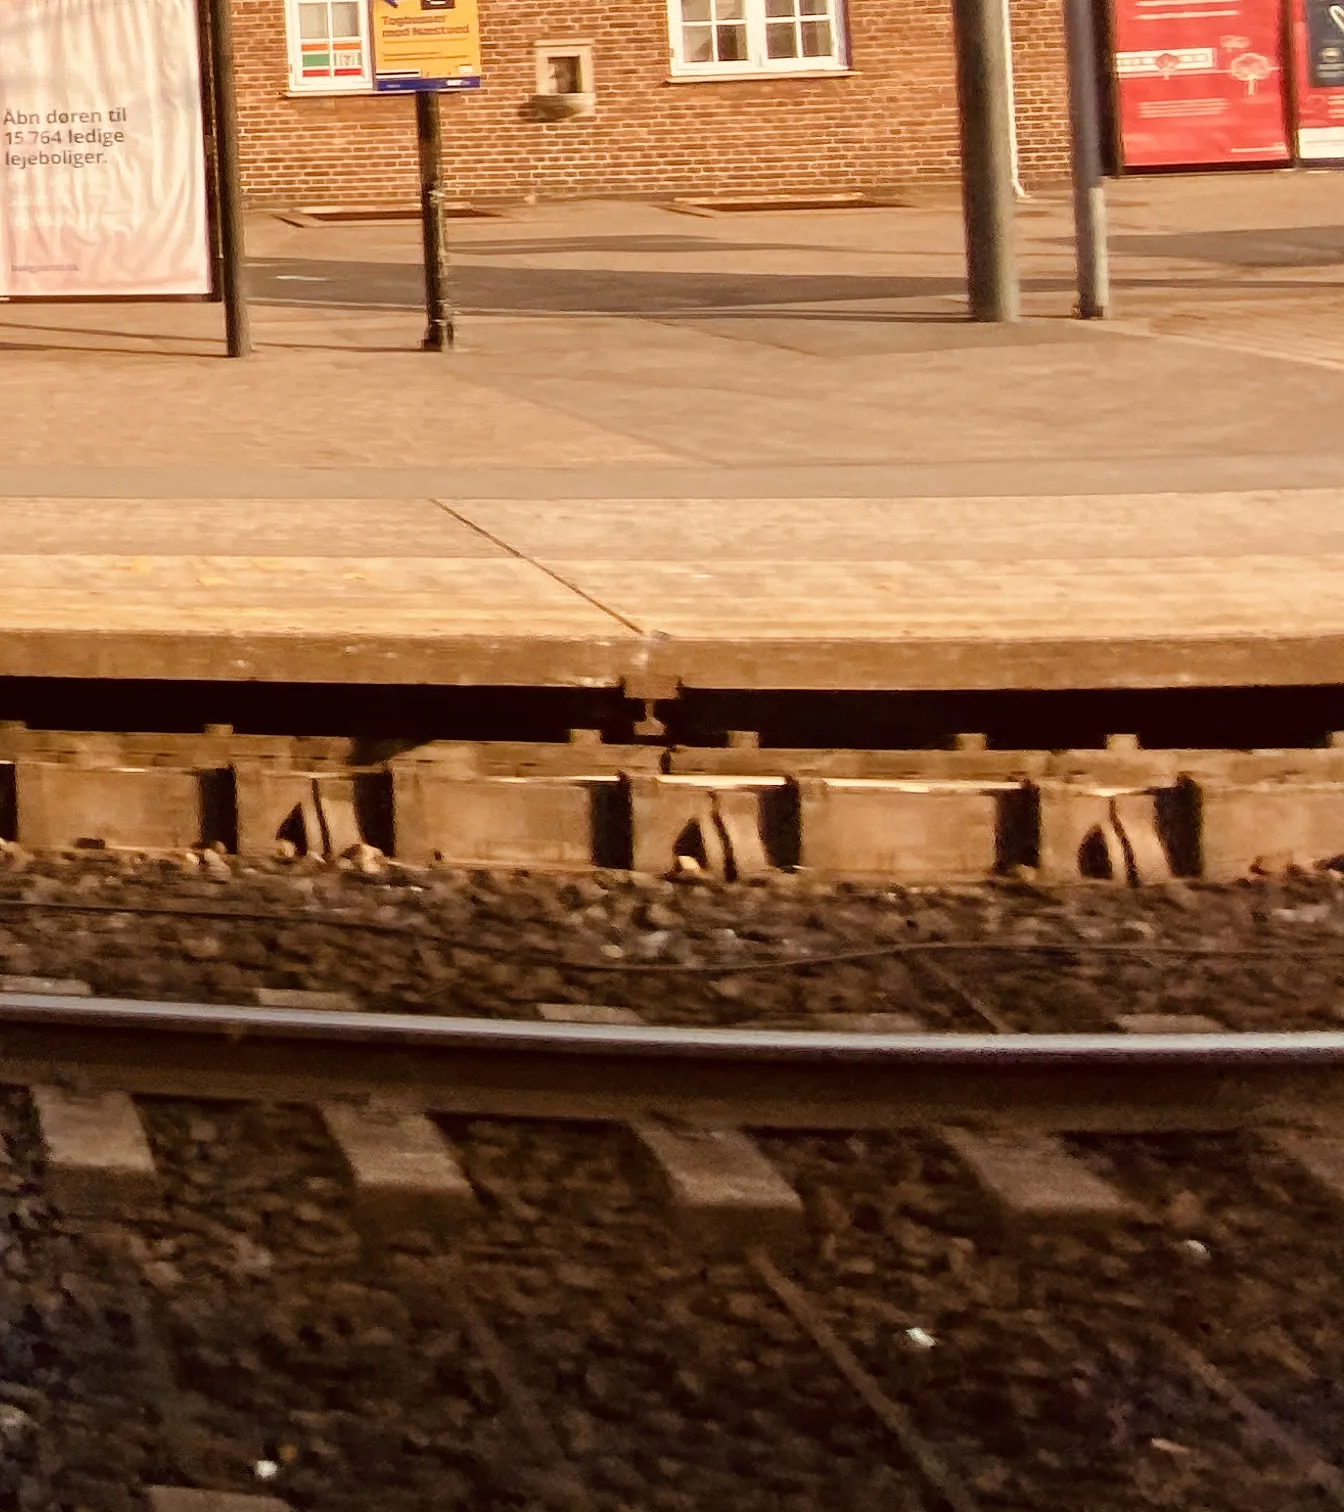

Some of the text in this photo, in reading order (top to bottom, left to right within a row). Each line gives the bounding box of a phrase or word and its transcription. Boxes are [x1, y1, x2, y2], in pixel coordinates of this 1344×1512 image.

[2, 106, 128, 126] Åbn døren til
[67, 128, 125, 148] ledige
[4, 149, 108, 170] lejeboliger.
